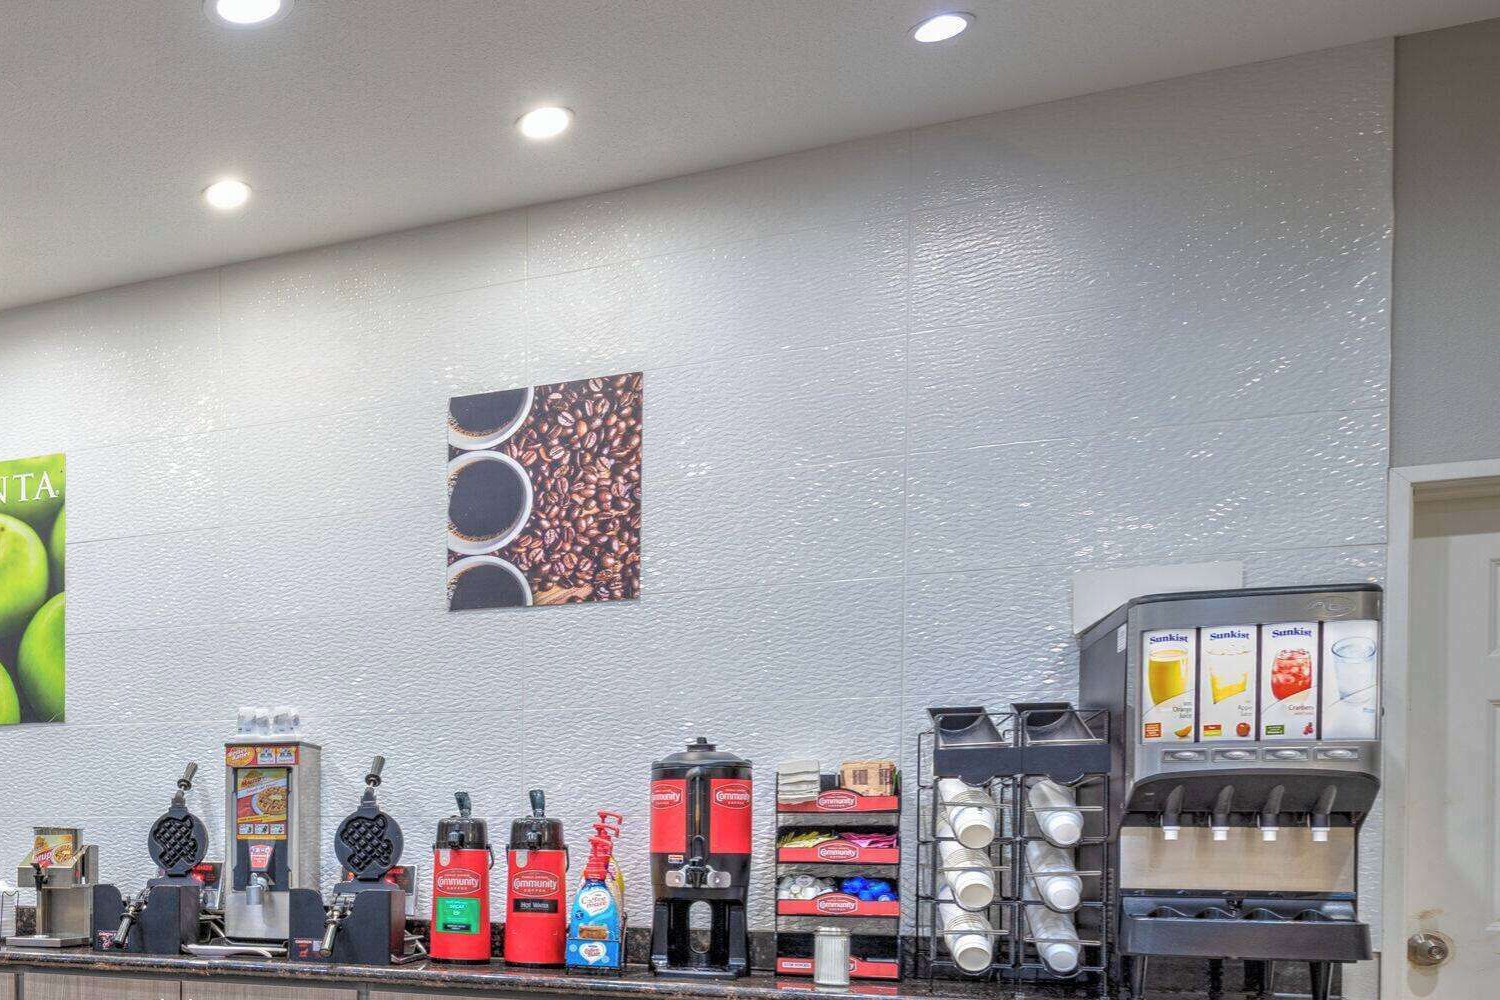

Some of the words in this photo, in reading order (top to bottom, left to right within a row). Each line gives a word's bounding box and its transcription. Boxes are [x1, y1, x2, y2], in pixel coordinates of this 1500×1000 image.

[1209, 630, 1250, 641] Sunkist
[1271, 627, 1313, 638] Sunkist
[1149, 633, 1189, 645] Sunkist
[437, 876, 479, 888] Community
[513, 878, 557, 890] Community
